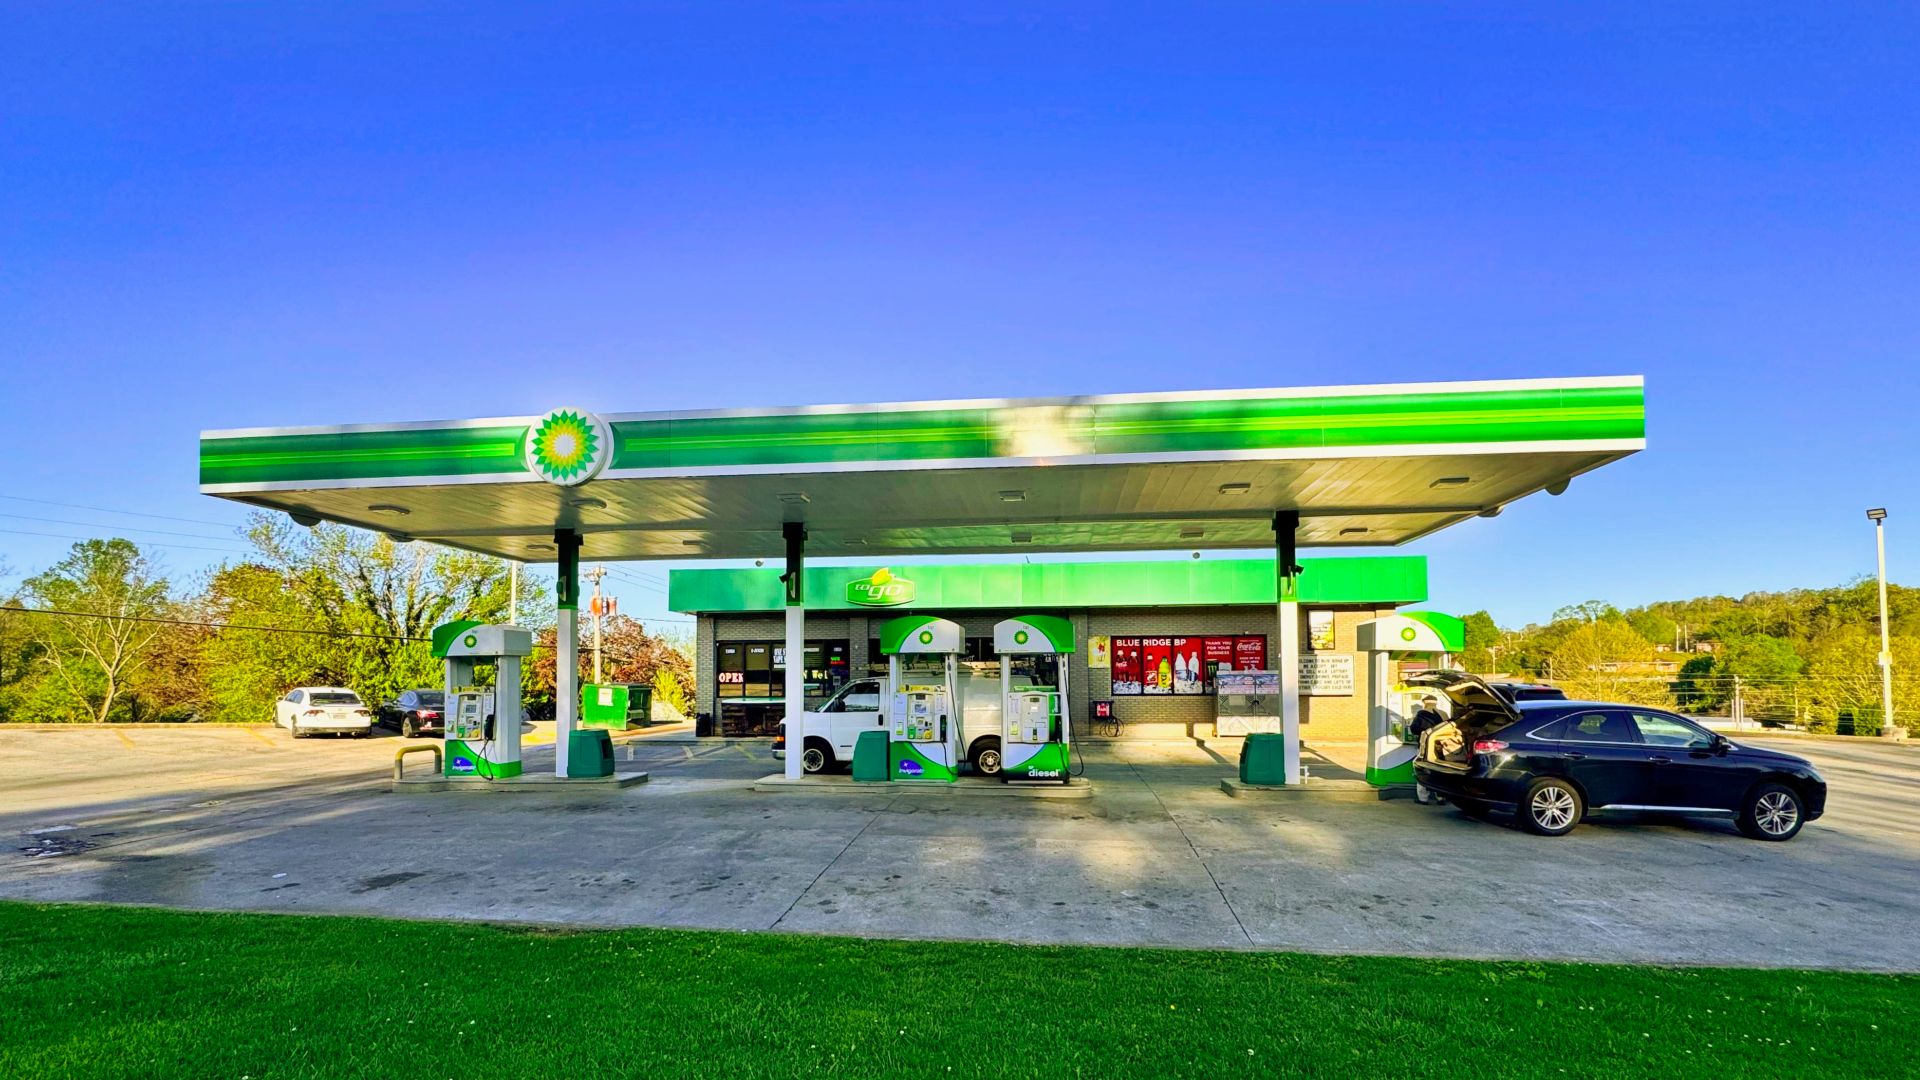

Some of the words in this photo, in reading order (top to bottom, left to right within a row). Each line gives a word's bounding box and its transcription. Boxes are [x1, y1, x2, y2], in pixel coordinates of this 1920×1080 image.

[867, 585, 904, 601] go
[1116, 639, 1140, 647] BLUE
[1174, 638, 1187, 646] BP
[718, 672, 744, 683] OPEN
[1028, 769, 1060, 777] diesel
